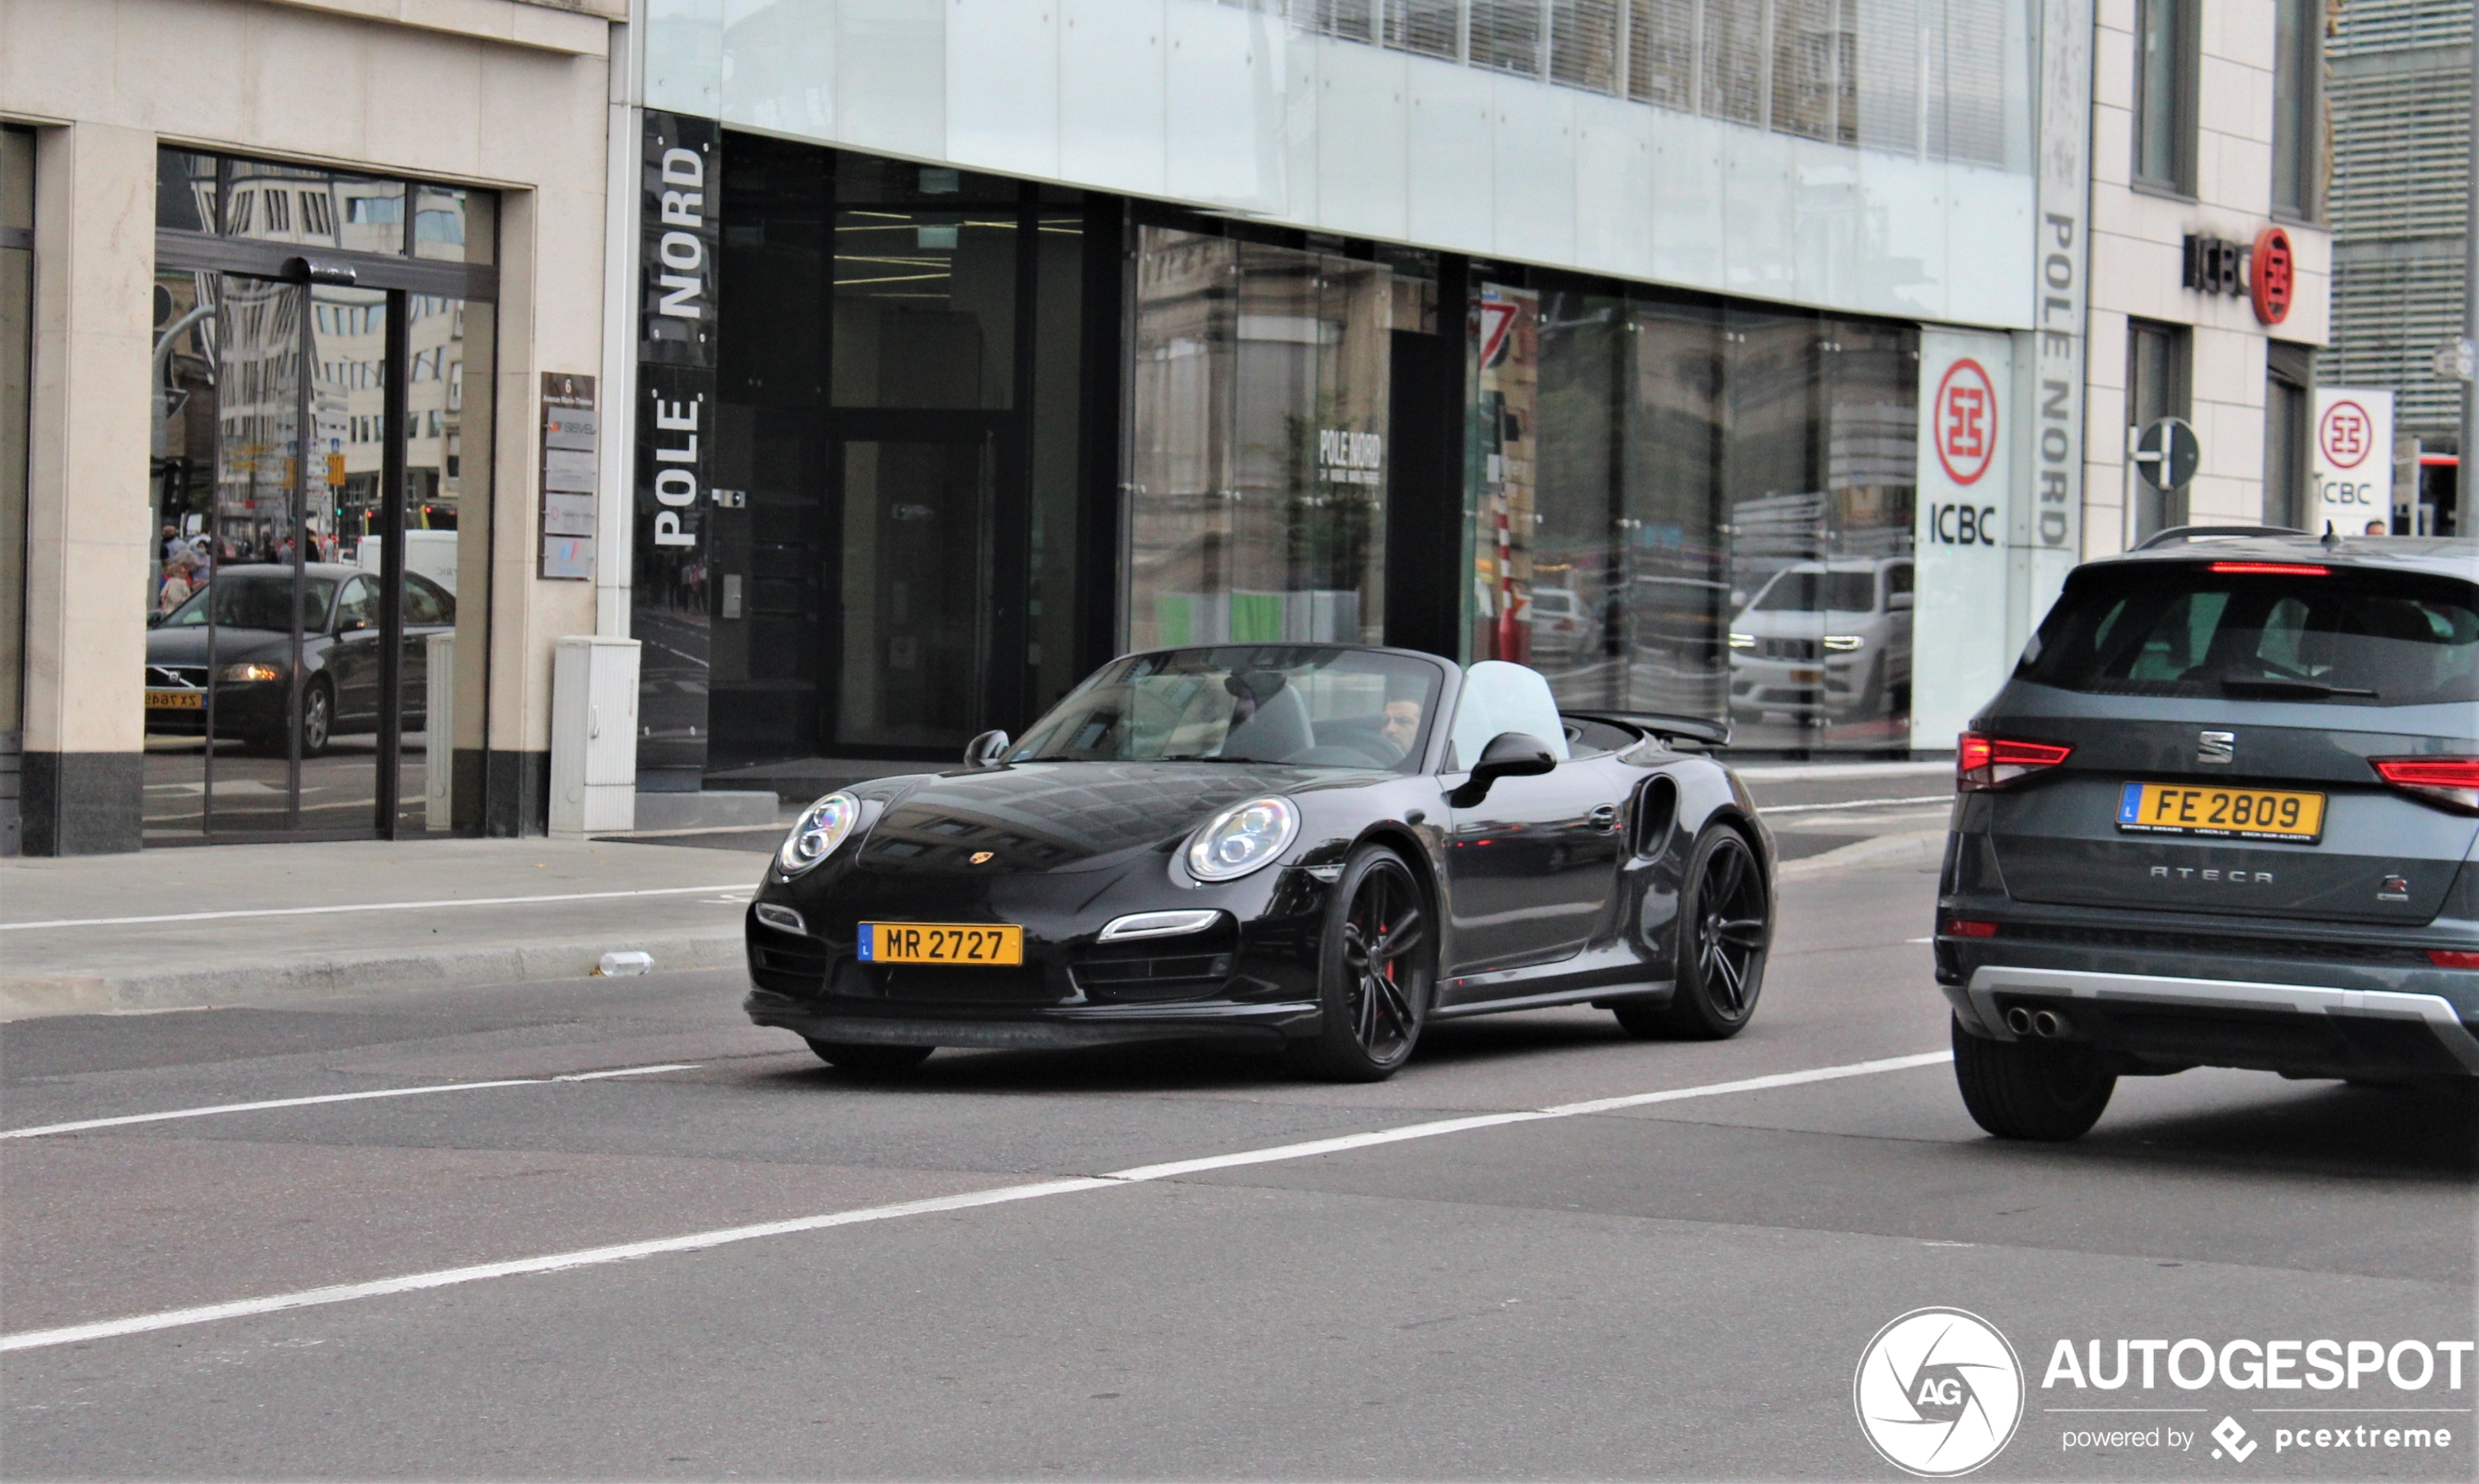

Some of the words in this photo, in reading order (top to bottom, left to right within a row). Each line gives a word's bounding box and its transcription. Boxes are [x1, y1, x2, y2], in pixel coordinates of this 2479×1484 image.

[660, 147, 704, 318] NORD
[2044, 212, 2075, 360] POLE
[565, 379, 572, 394] 6
[1320, 429, 1348, 465] POLE
[2040, 380, 2070, 546] NORD
[655, 399, 698, 546] POLE
[1930, 502, 1996, 546] ICBC
[2156, 789, 2202, 822] FE
[2208, 792, 2300, 828] 2809
[2150, 865, 2274, 884] ATECA
[886, 929, 921, 958] MR
[929, 930, 1003, 960] 2727
